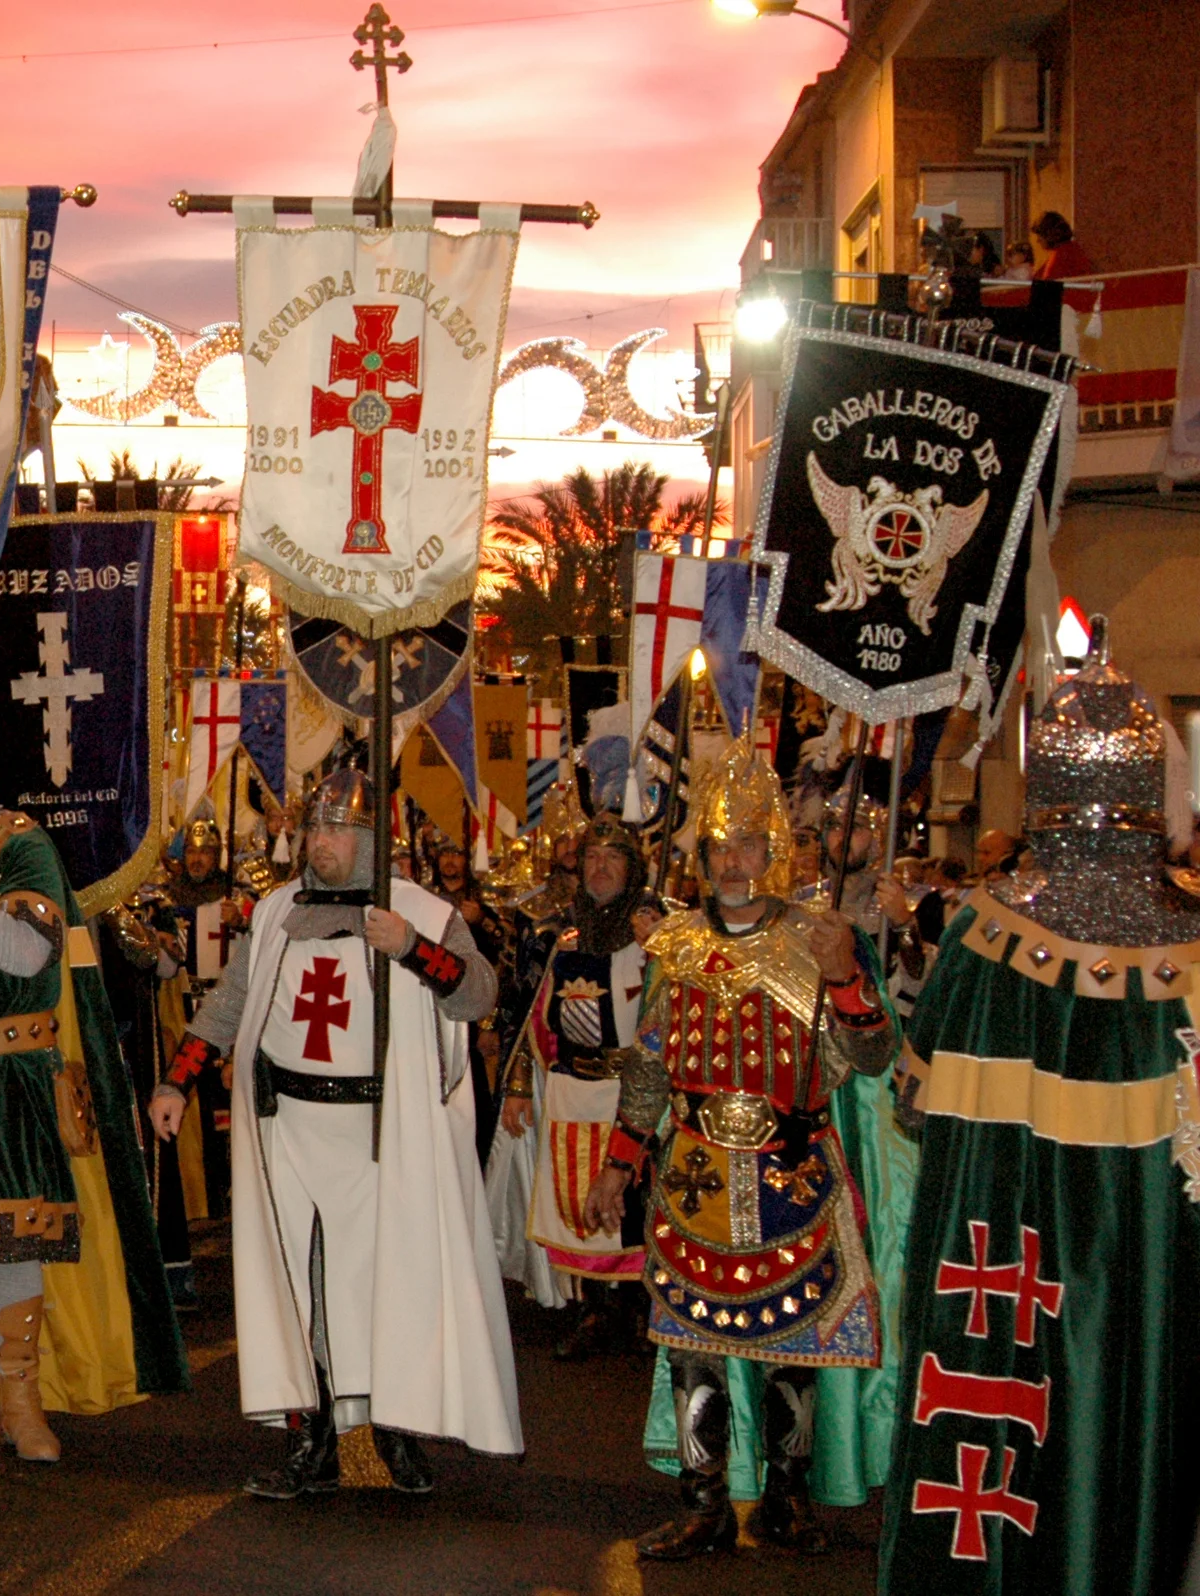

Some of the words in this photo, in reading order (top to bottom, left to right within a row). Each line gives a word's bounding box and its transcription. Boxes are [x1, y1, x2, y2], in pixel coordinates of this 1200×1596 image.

[24, 229, 52, 309] DEL
[247, 269, 357, 368] ESCUADRA
[375, 267, 488, 361] TEMLARIOS
[250, 425, 300, 450] 1991
[420, 427, 477, 453] 1992
[811, 387, 980, 442] CABALLEROS
[971, 437, 1003, 482] DE
[249, 453, 304, 475] 2000
[862, 432, 901, 462] LA
[912, 439, 964, 476] DOS
[260, 523, 378, 596] MONFORTE
[415, 533, 445, 570] CID
[856, 622, 908, 650] AÑO
[856, 648, 902, 672] 1980
